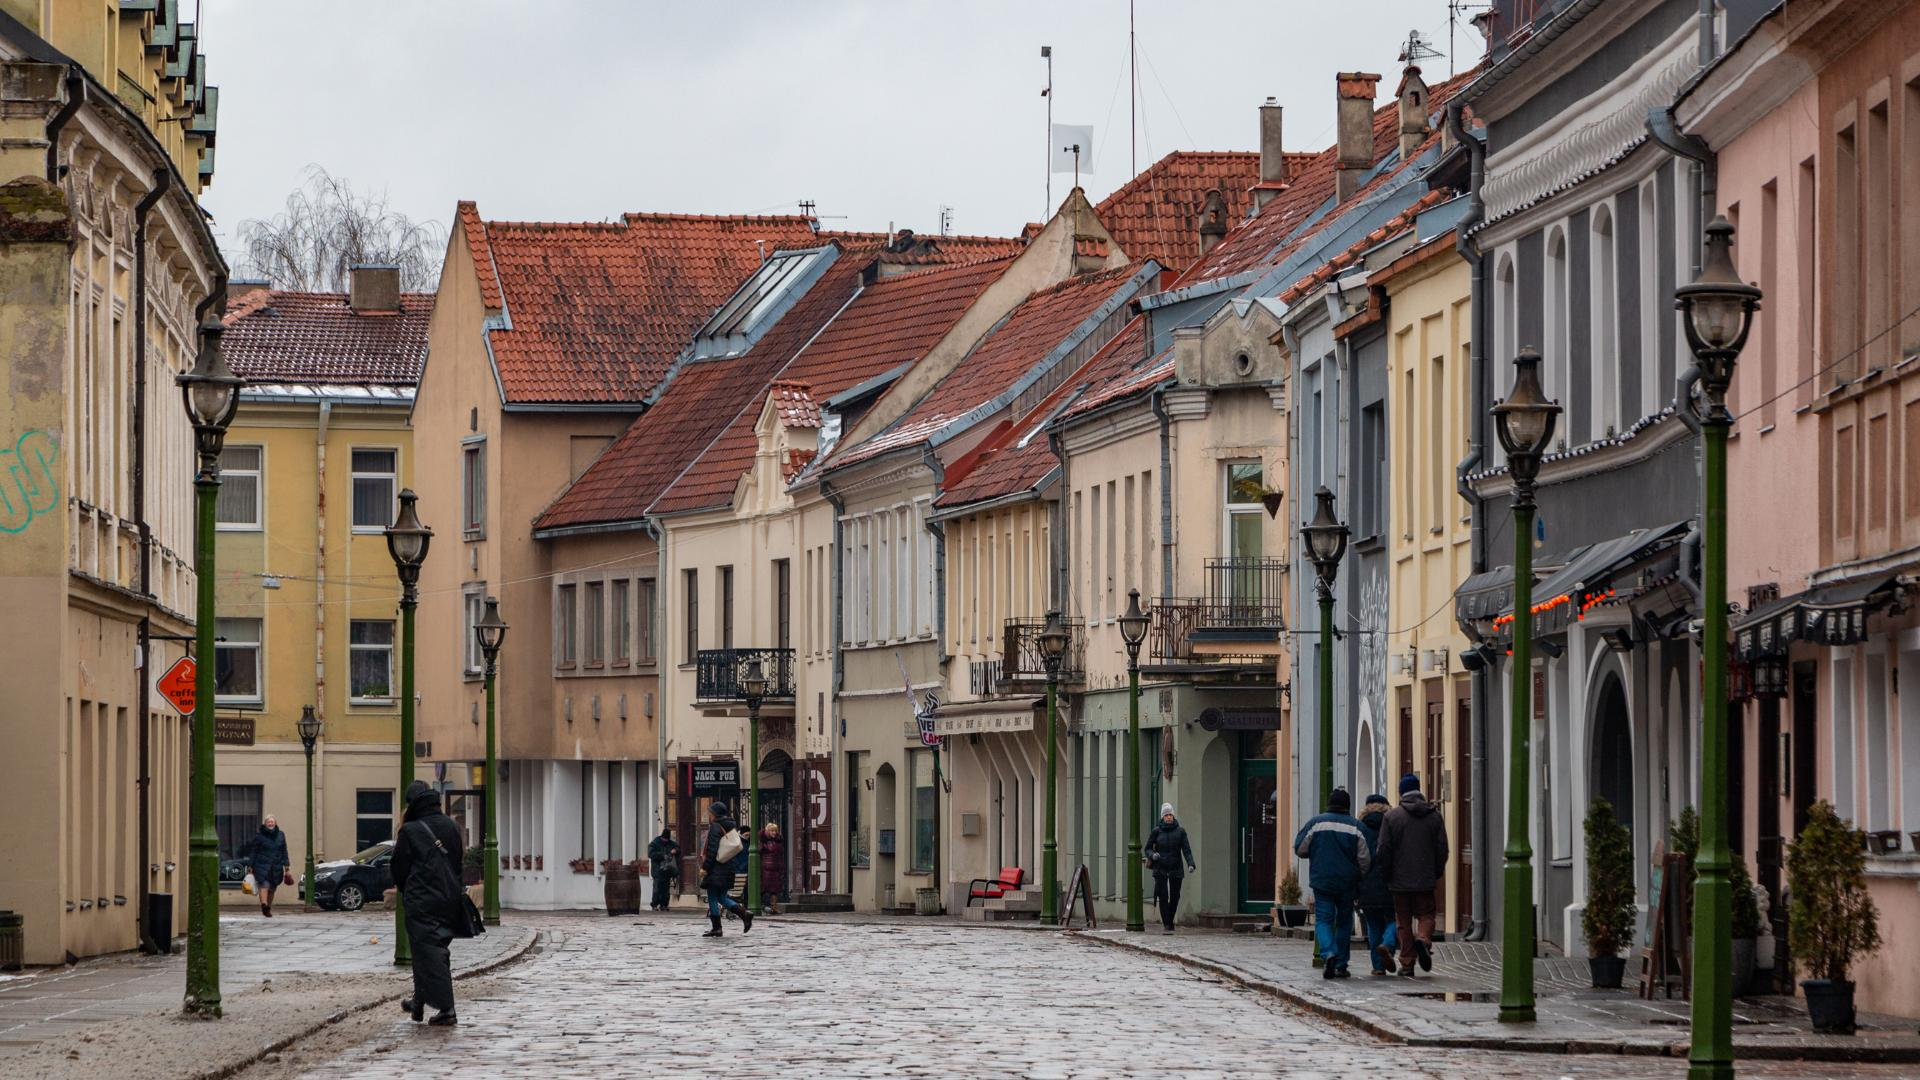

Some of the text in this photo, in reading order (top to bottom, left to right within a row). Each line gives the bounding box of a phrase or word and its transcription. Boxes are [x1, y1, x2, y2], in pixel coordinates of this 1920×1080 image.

[179, 697, 194, 706] inn
[695, 770, 735, 781] JACK PUB
